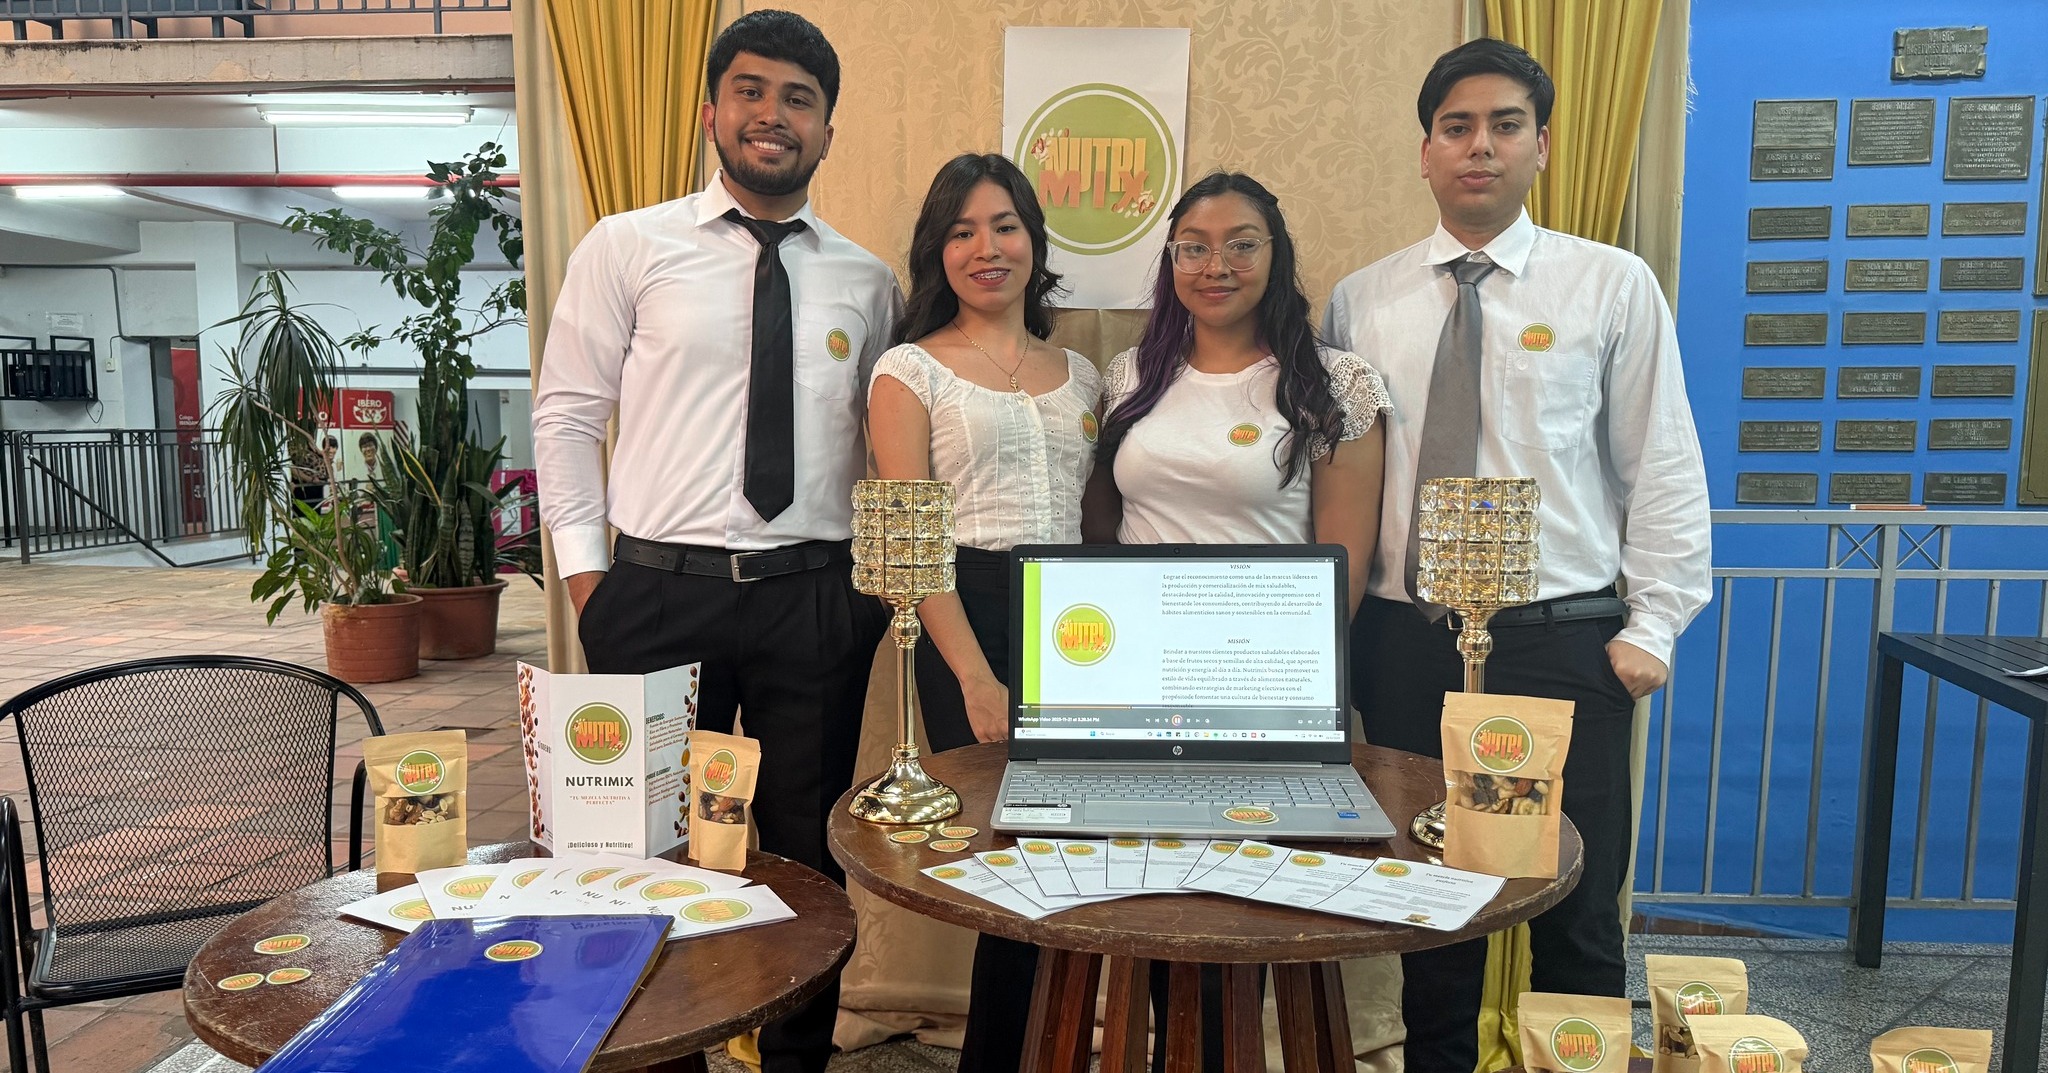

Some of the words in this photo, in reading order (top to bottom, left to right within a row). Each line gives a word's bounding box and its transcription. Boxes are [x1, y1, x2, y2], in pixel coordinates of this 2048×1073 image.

[1045, 136, 1147, 193] NUTRI
[1038, 169, 1149, 209] MIX
[357, 399, 383, 408] IBERO
[1270, 592, 1304, 600] compromiso
[1064, 622, 1104, 643] NUTRI
[1264, 658, 1286, 666] calidad,
[1297, 658, 1319, 666] aporten
[1196, 685, 1225, 693] estrategias
[1233, 685, 1261, 693] marketing
[579, 721, 620, 742] NUTRI
[575, 733, 621, 748] MIX
[1481, 732, 1523, 753] NUTRI
[405, 763, 438, 778] NUTRI
[565, 776, 634, 787] NUTRIMIX
[1560, 1033, 1597, 1052] NUTRI
